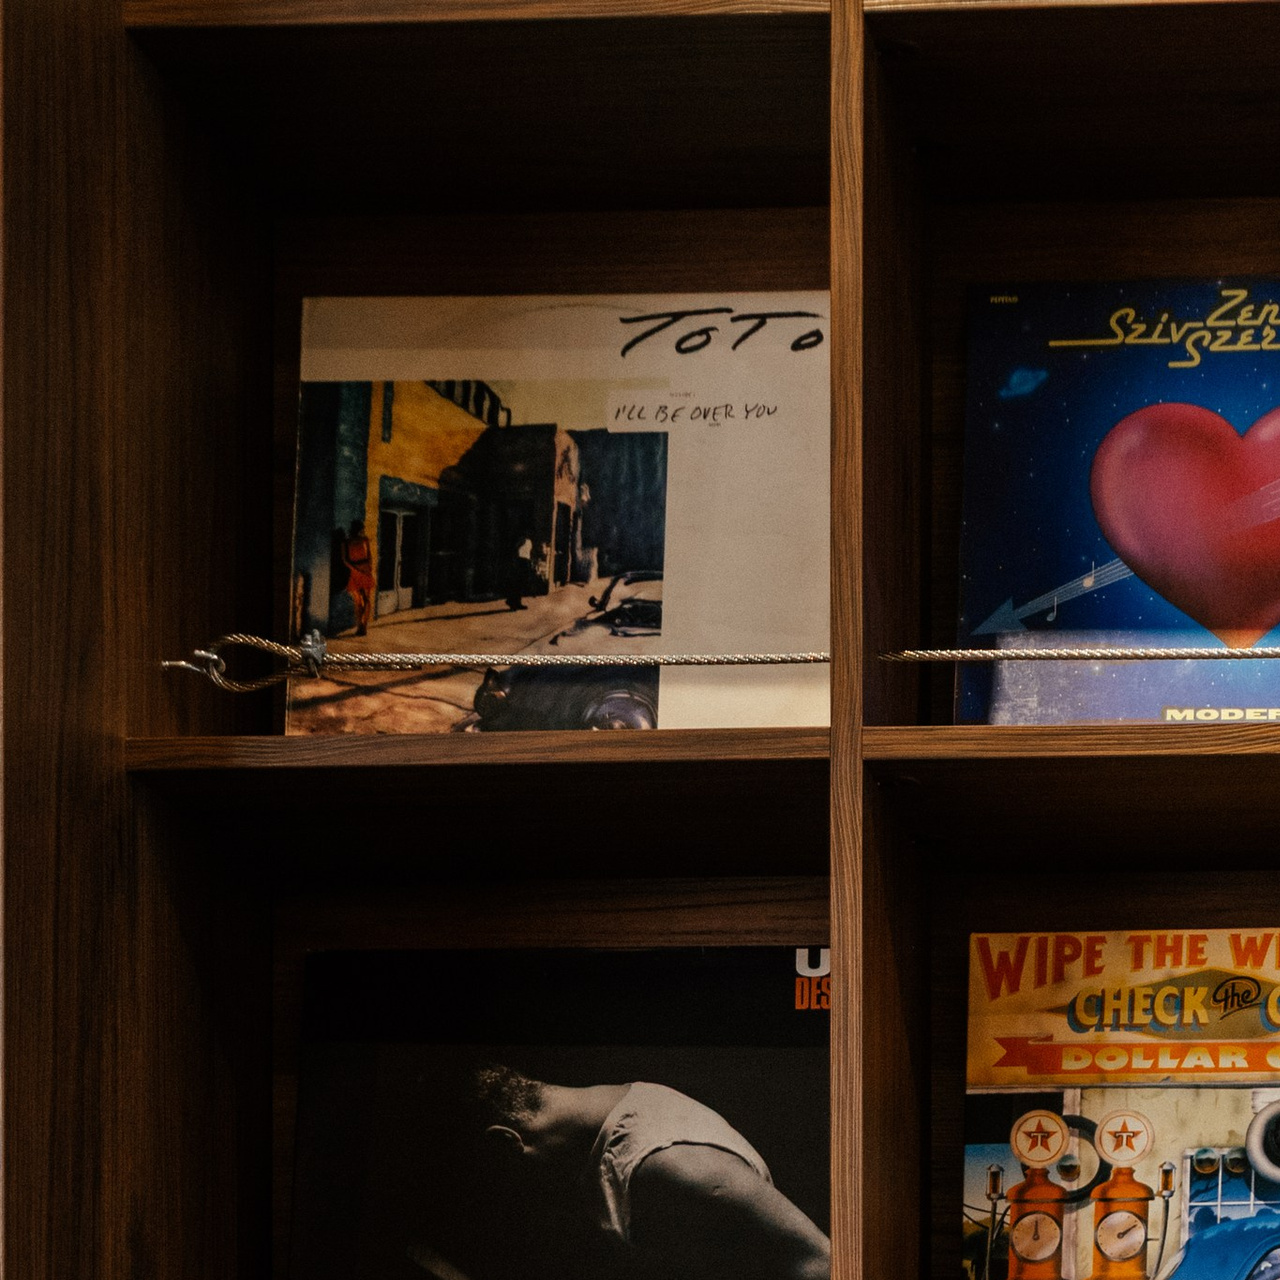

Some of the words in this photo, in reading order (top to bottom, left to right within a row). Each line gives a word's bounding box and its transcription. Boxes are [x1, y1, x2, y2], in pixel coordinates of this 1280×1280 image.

[614, 404, 646, 421] I'LL
[655, 405, 684, 423] BE
[690, 403, 735, 421] OVER
[744, 403, 777, 420] YOU
[977, 936, 1106, 1002] WIPE
[1128, 934, 1209, 970] THE
[1067, 984, 1210, 1034] CHECK
[1210, 975, 1263, 1020] the
[1061, 1045, 1249, 1071] DOLLAR
